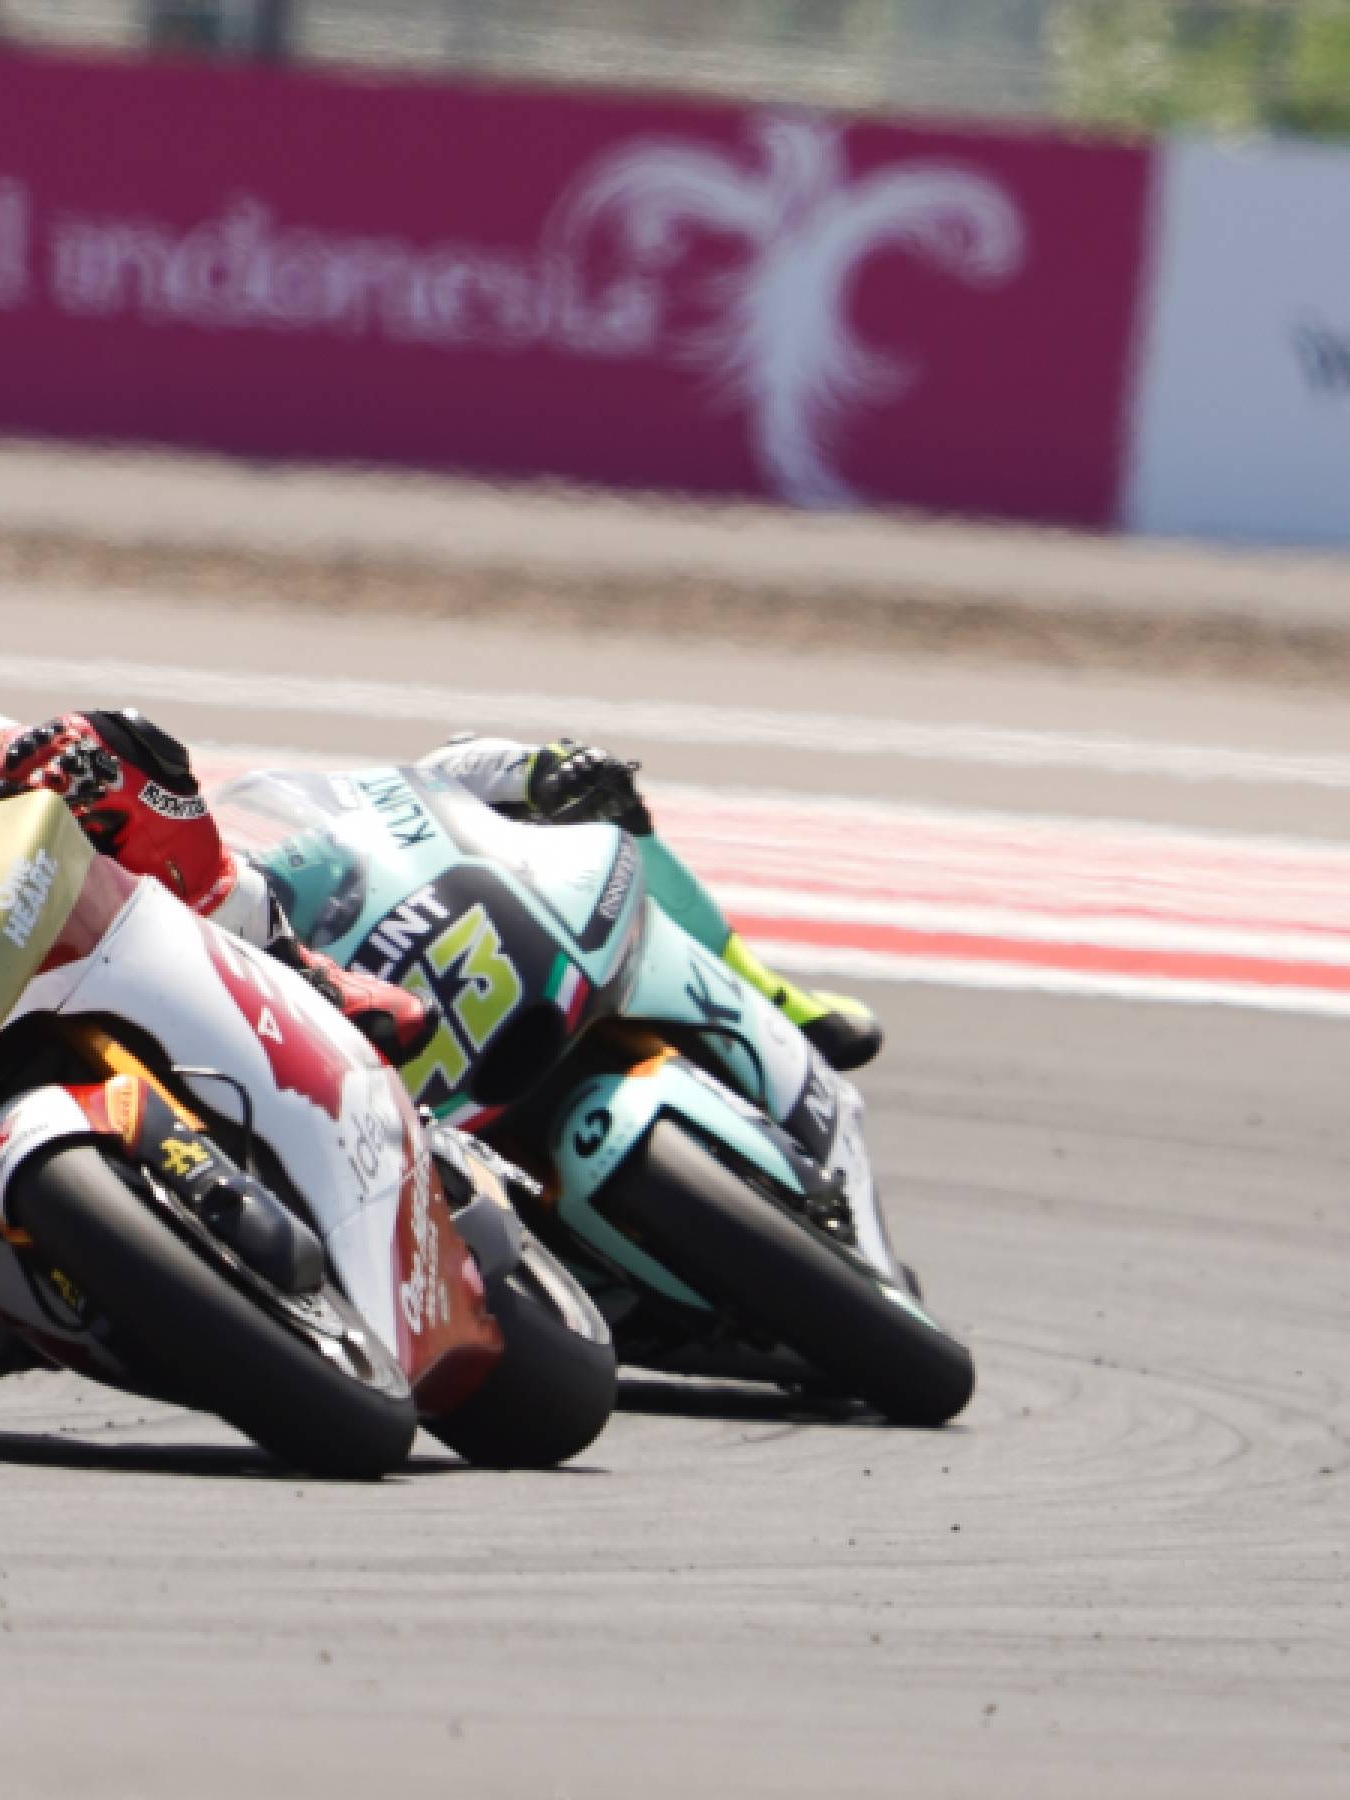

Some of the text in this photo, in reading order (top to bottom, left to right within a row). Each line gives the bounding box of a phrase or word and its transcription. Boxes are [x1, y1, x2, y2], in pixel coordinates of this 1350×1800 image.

[52, 198, 658, 360] indonesia
[356, 770, 437, 850] KLINT
[350, 884, 450, 985] LINT
